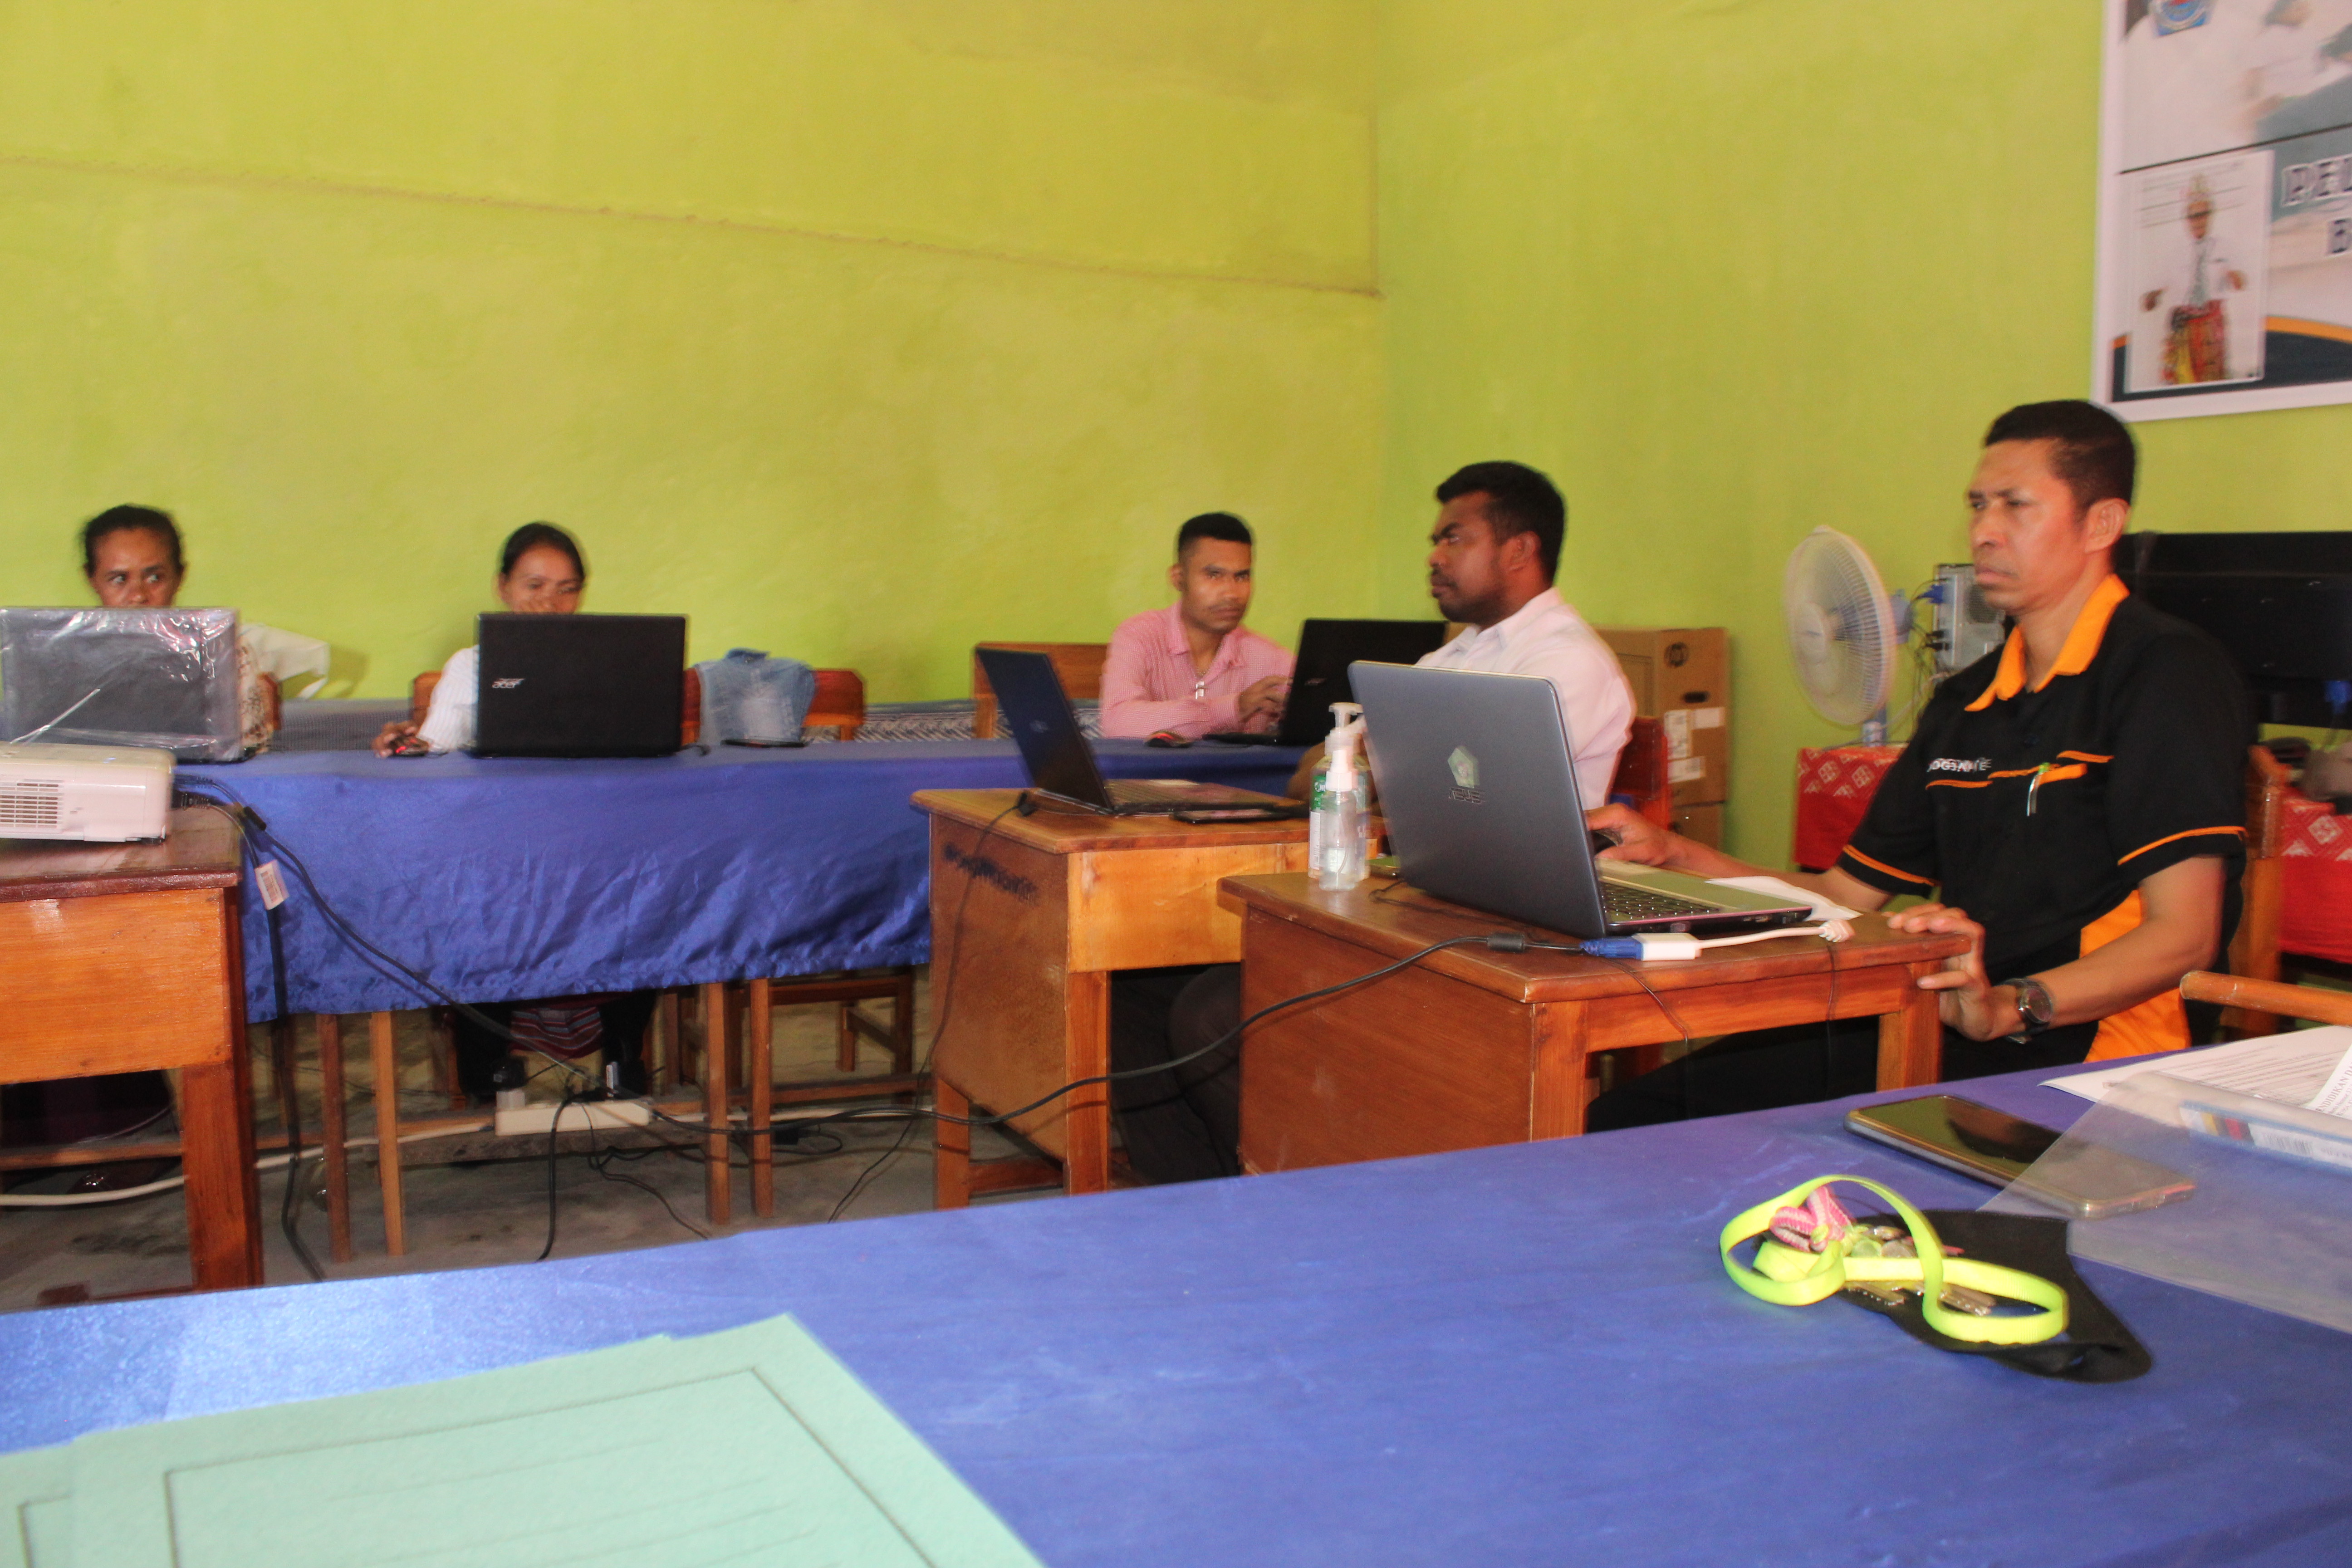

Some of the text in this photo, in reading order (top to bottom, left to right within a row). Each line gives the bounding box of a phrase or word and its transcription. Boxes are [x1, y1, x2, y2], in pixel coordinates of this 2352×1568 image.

[492, 678, 524, 688] acer
[1448, 787, 1483, 804] ASUS
[2315, 1076, 2350, 1112] ENDIDIKAN
